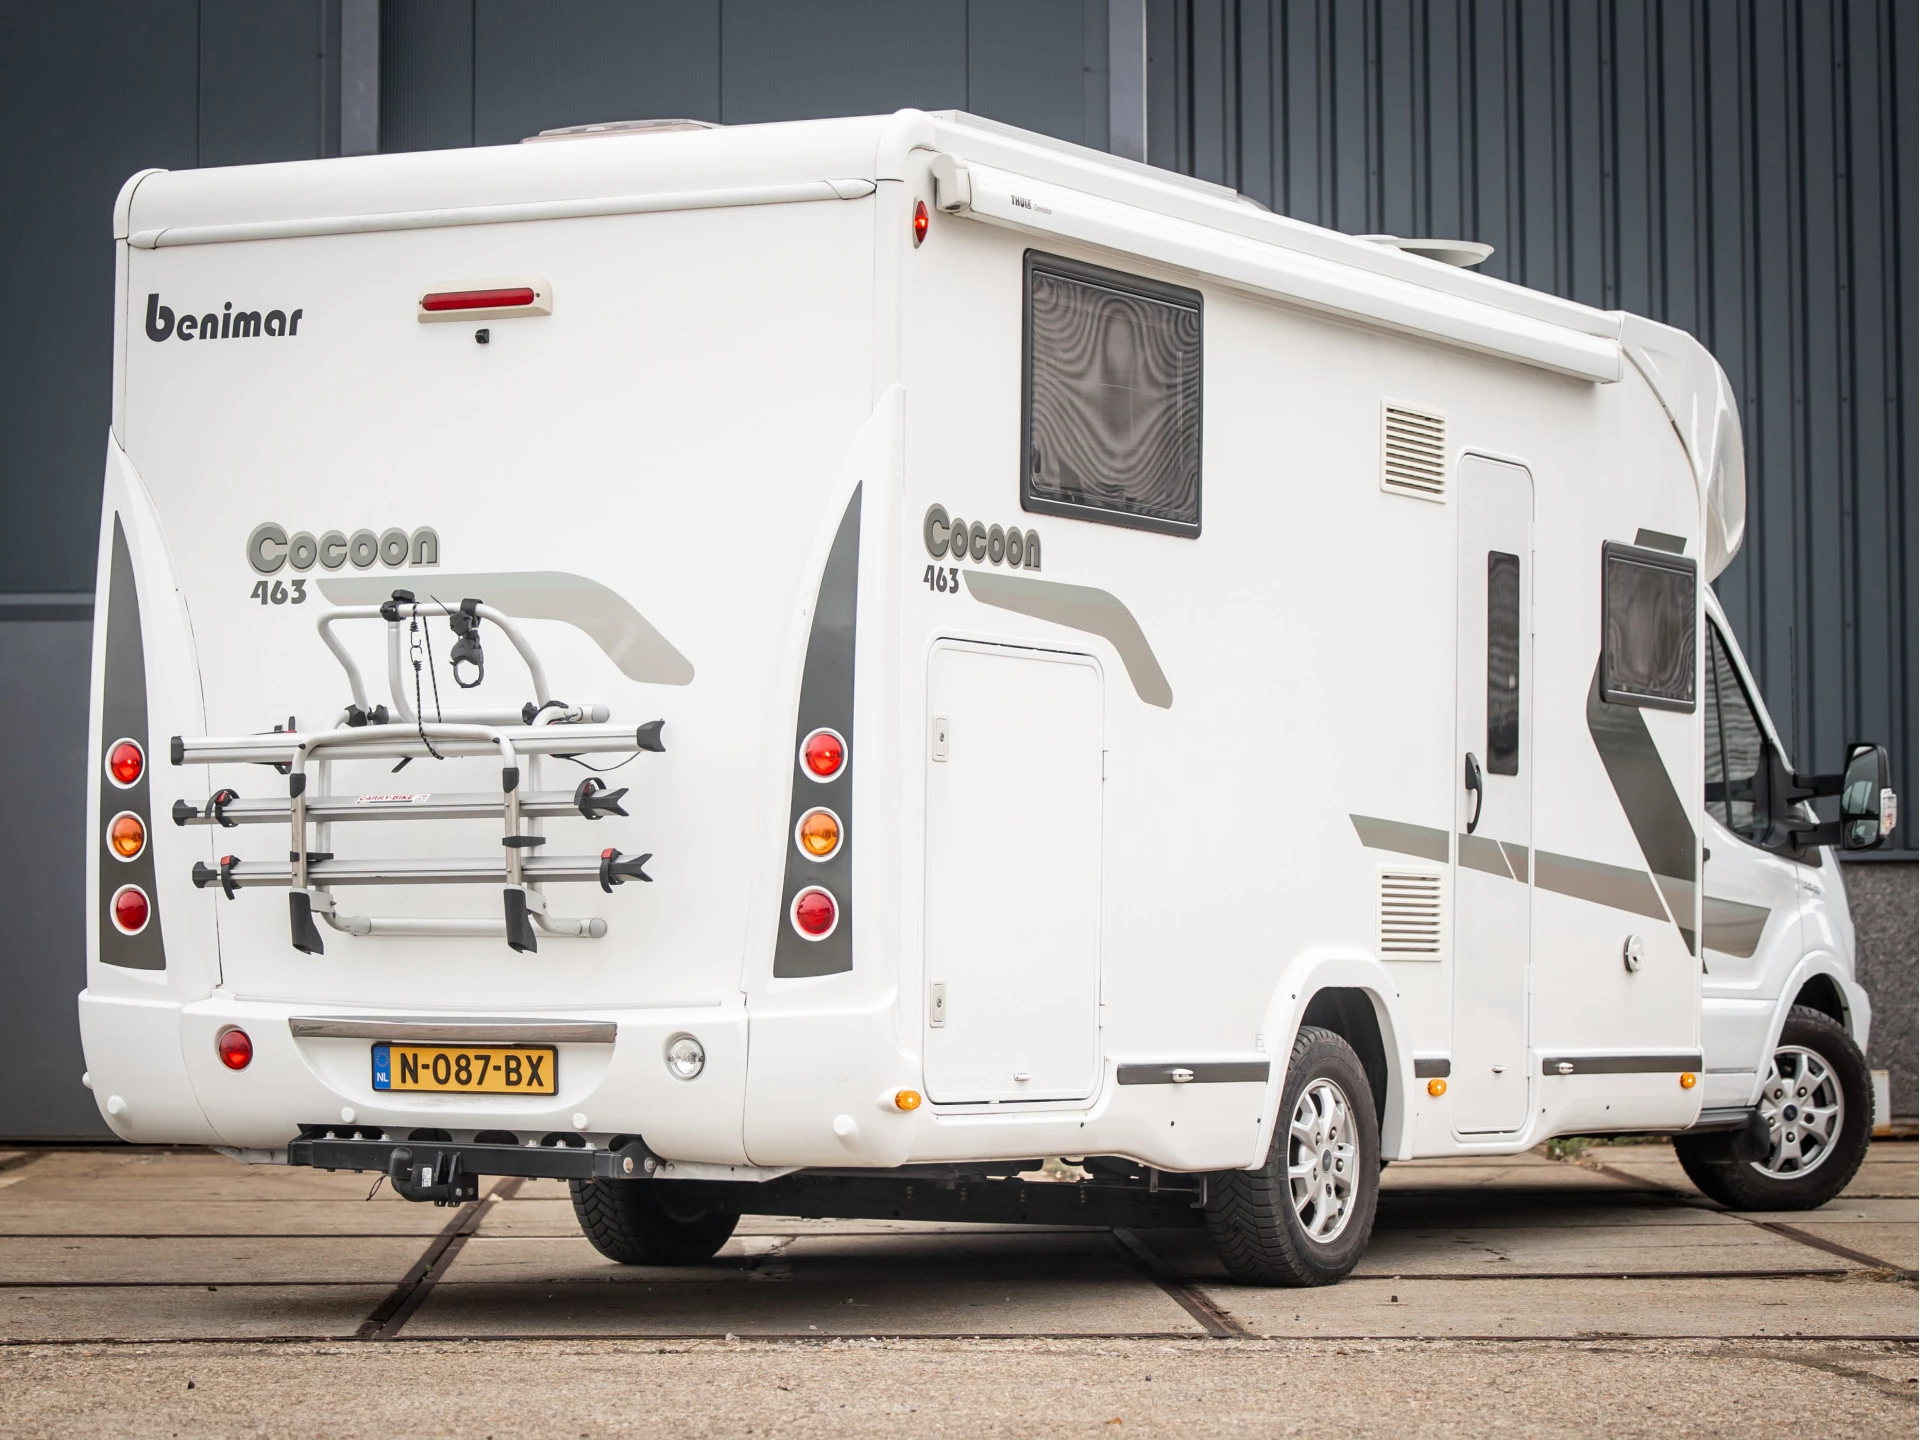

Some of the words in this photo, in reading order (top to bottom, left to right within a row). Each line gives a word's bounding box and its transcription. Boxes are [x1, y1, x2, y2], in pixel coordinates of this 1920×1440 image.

[1011, 194, 1032, 210] THULE
[145, 293, 303, 342] benimar
[246, 522, 440, 576] Cocoon
[923, 503, 1041, 572] Cocoon
[250, 579, 307, 605] 463
[923, 565, 959, 594] 463
[359, 793, 415, 801] CARRY-BIKE
[376, 1072, 389, 1083] NL
[400, 1053, 544, 1087] N-087-BX
